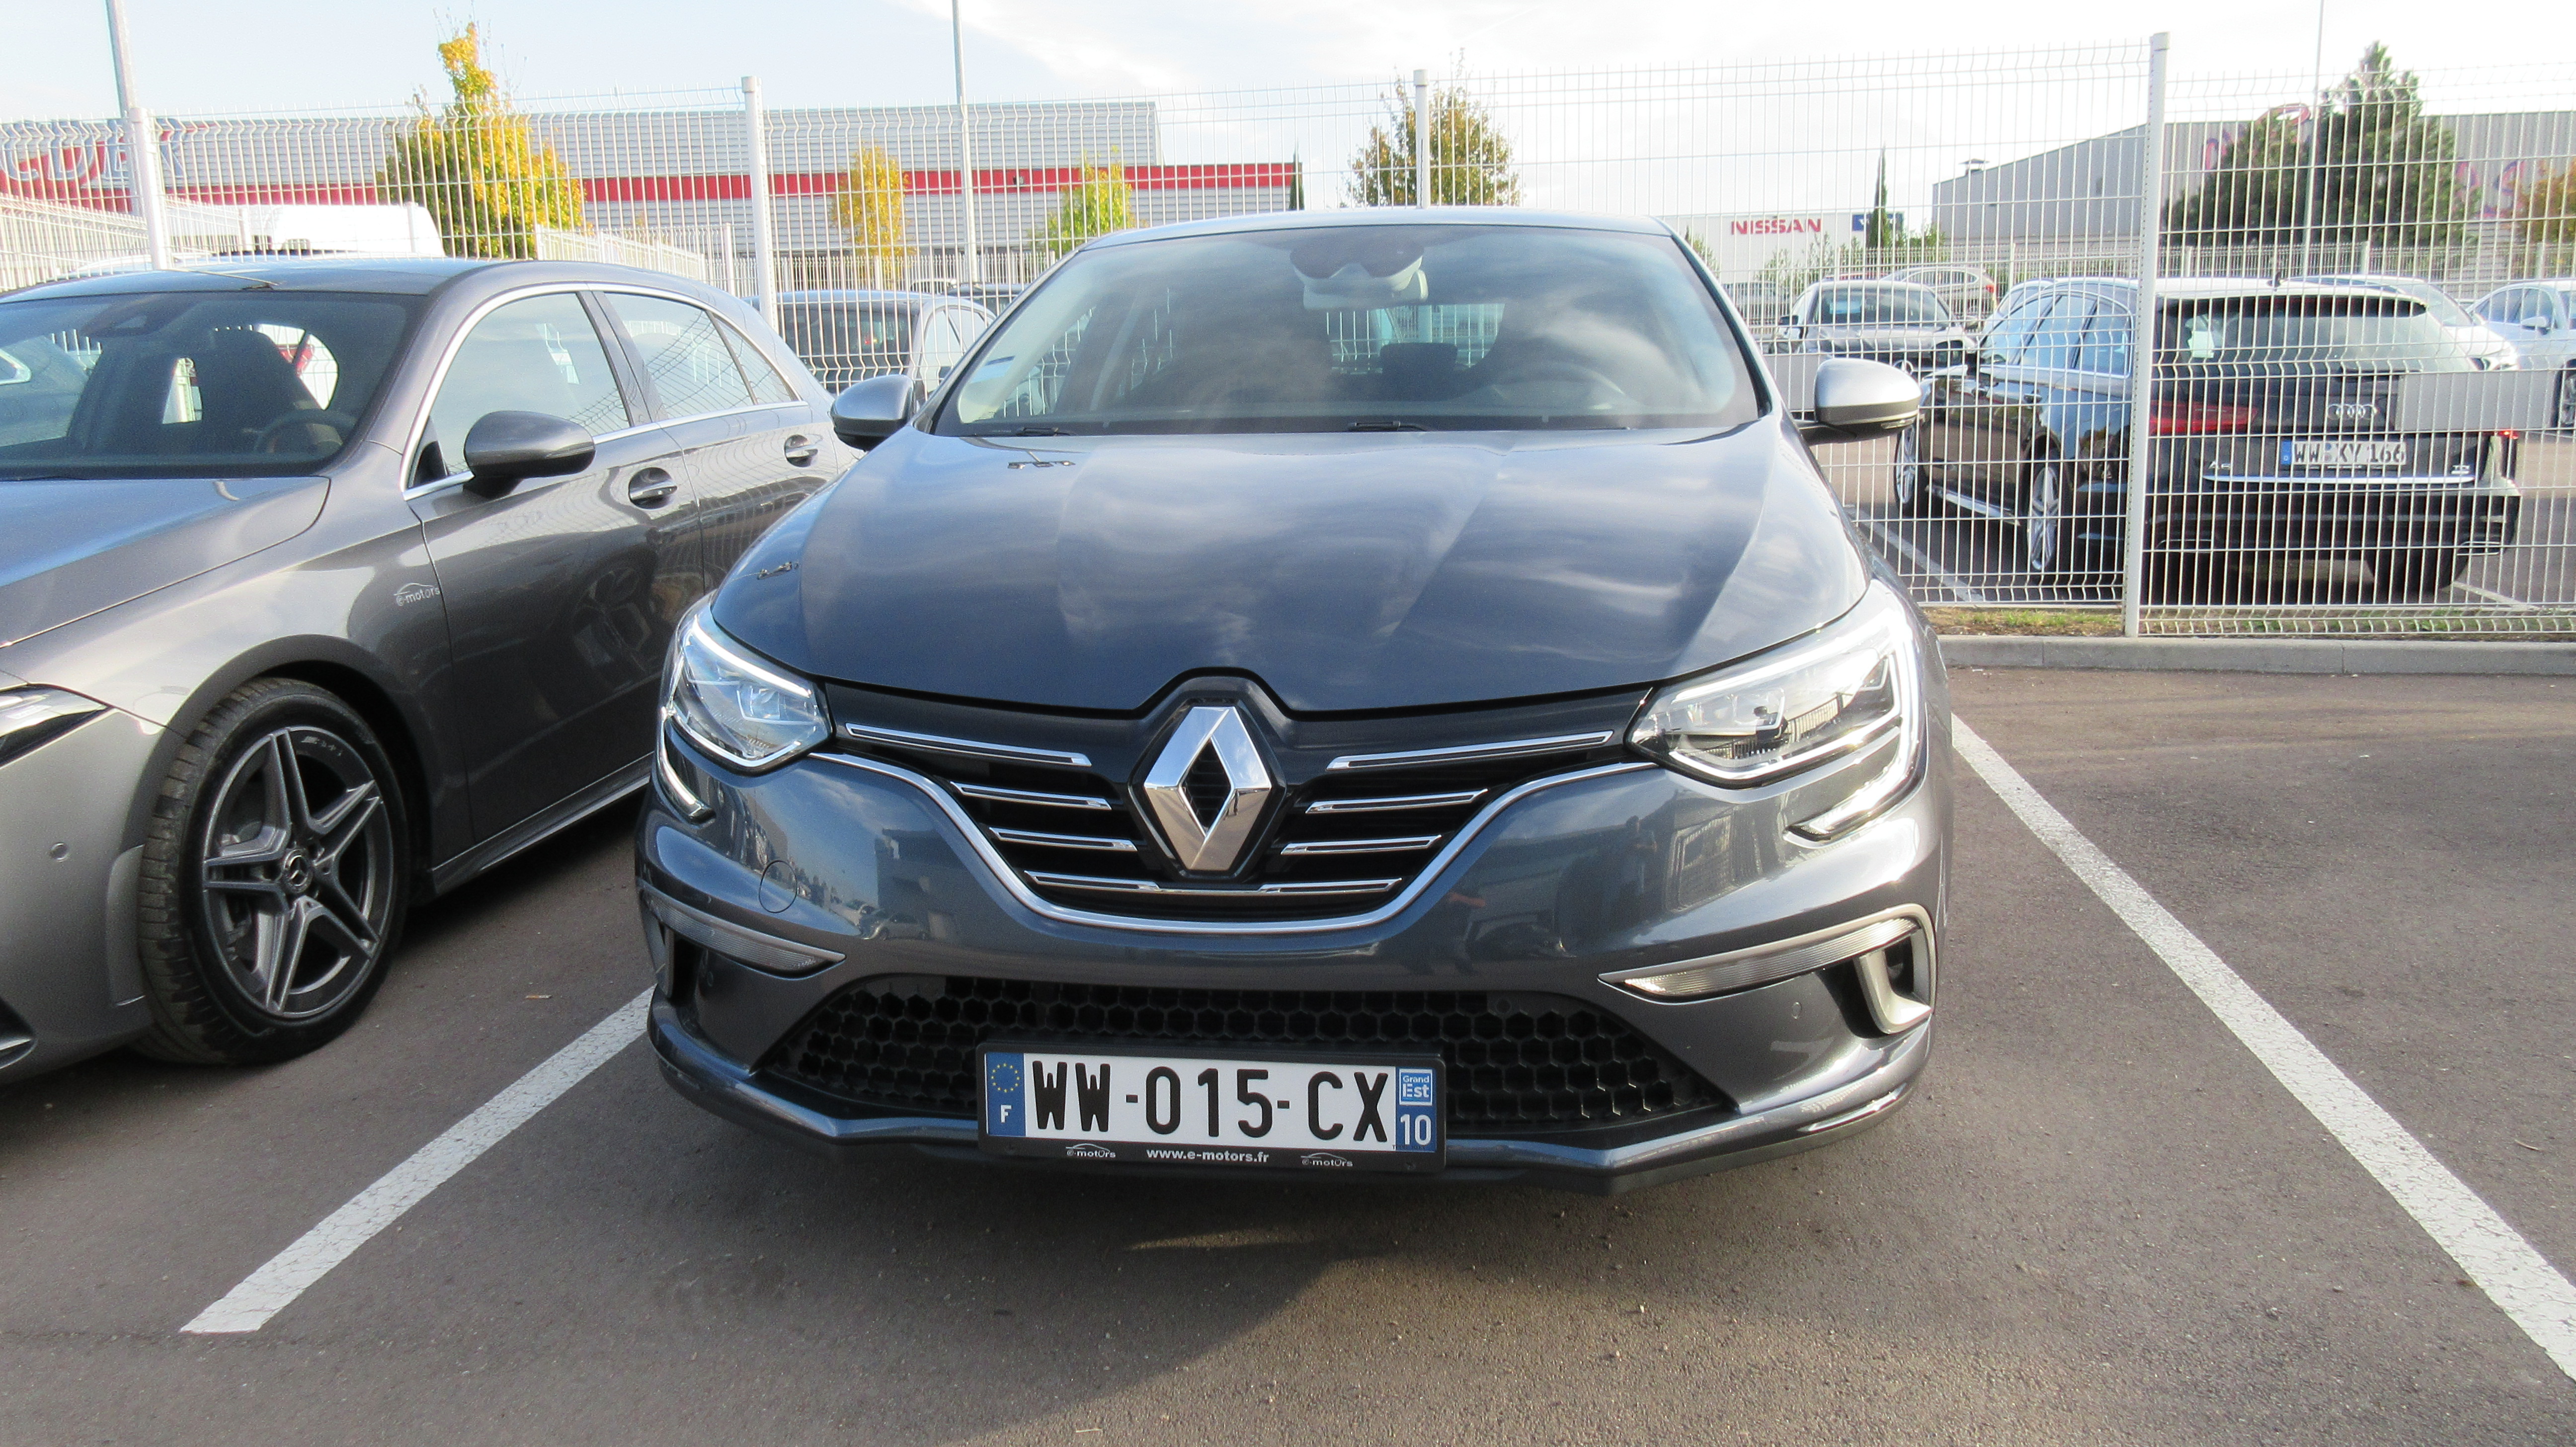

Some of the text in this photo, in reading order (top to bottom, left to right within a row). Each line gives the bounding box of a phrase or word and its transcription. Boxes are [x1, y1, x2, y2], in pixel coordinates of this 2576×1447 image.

[1731, 218, 1822, 235] NISSAN
[2367, 444, 2405, 463] 166
[1402, 1083, 1430, 1097] Est
[1000, 1104, 1012, 1123] F
[1400, 1114, 1432, 1145] 10
[1146, 1149, 1270, 1162] www.e-motors.fr
